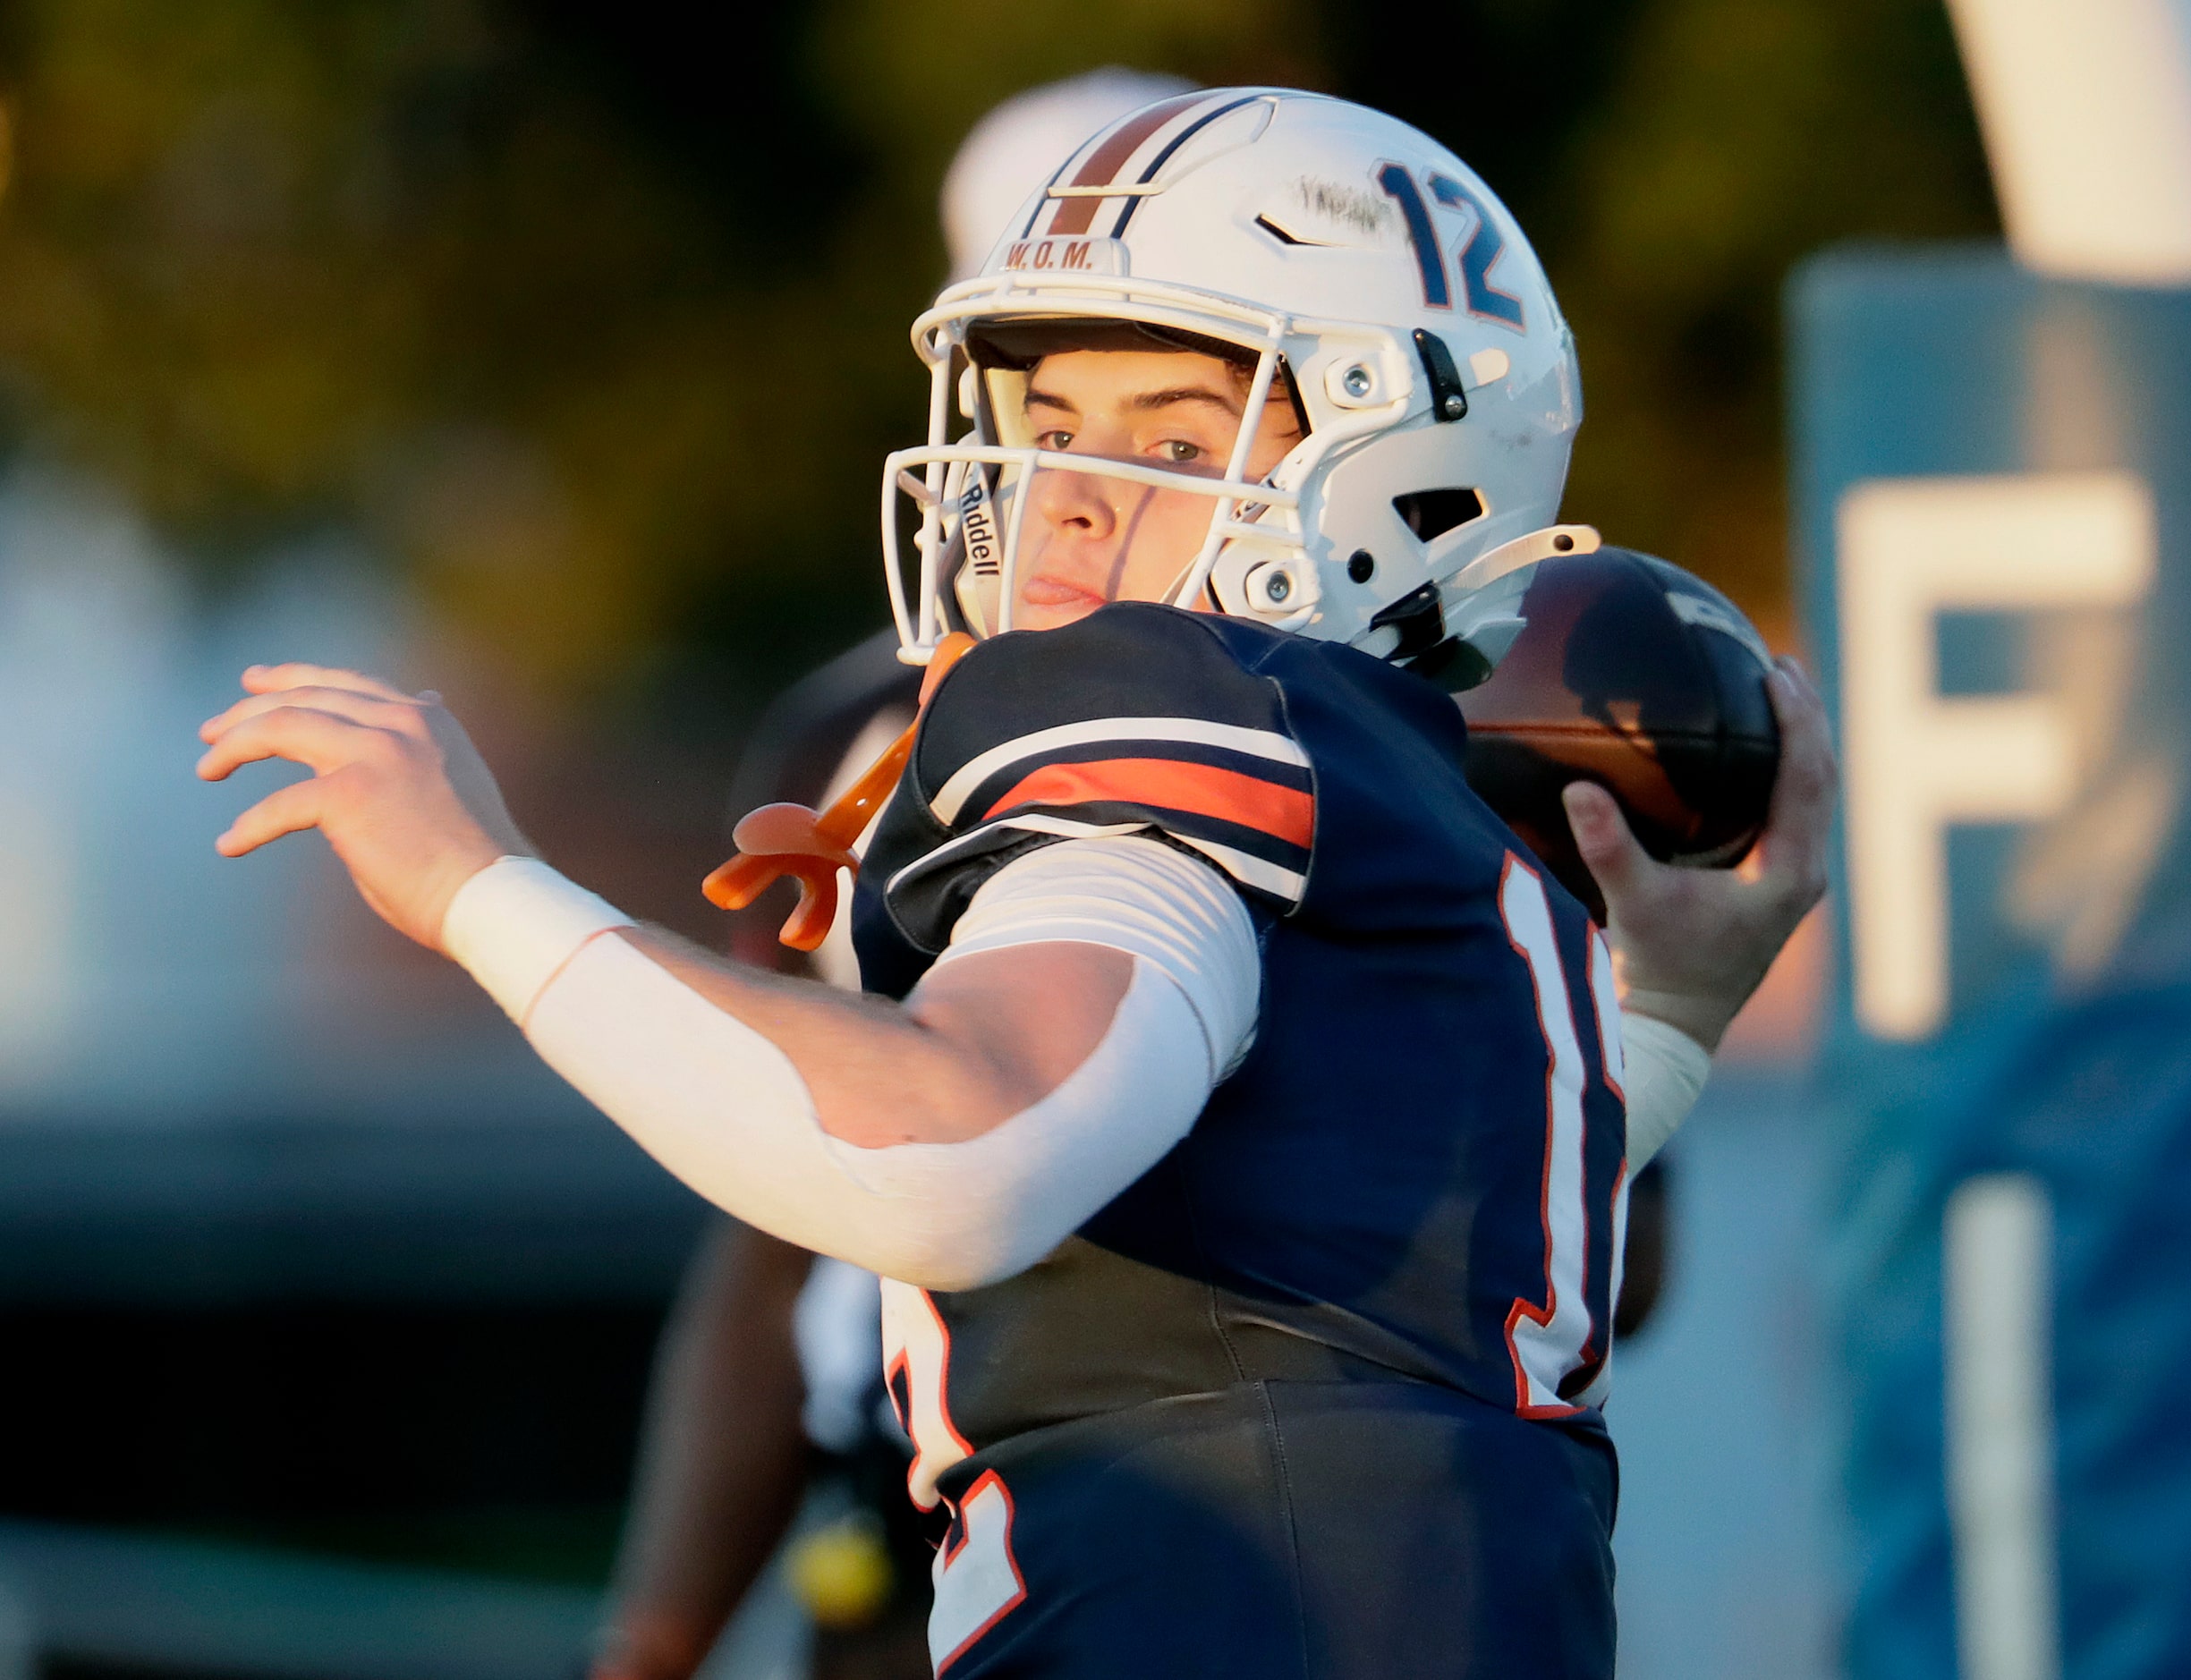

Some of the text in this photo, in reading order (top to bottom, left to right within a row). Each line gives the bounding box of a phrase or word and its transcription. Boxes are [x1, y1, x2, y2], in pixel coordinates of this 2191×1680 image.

[1032, 241, 1055, 269] O.
[1061, 241, 1093, 270] M.
[1375, 161, 1526, 334] 12
[961, 483, 1000, 576] Riddell
